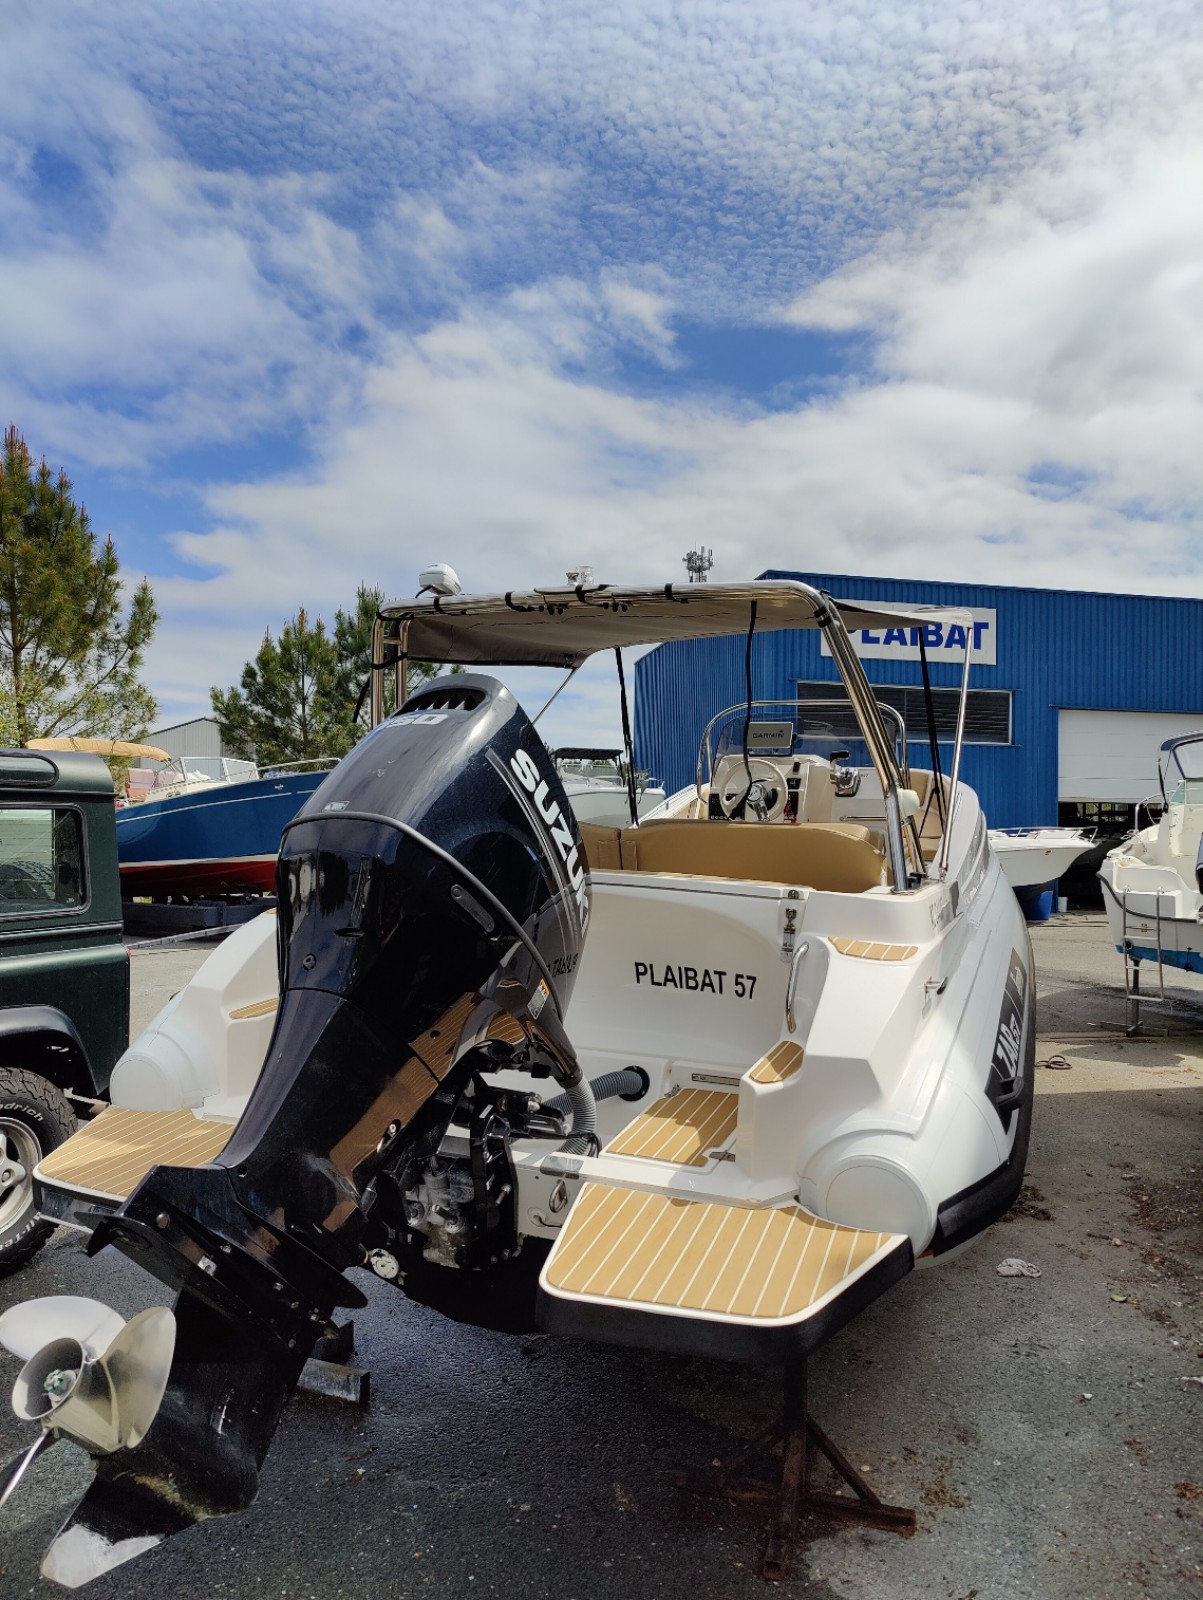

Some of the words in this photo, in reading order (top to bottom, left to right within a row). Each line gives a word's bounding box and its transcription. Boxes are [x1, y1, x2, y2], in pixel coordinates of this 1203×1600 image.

[634, 961, 728, 995] PLAIBAT
[734, 973, 758, 1000] 57
[996, 1023, 1019, 1078] ZAR
